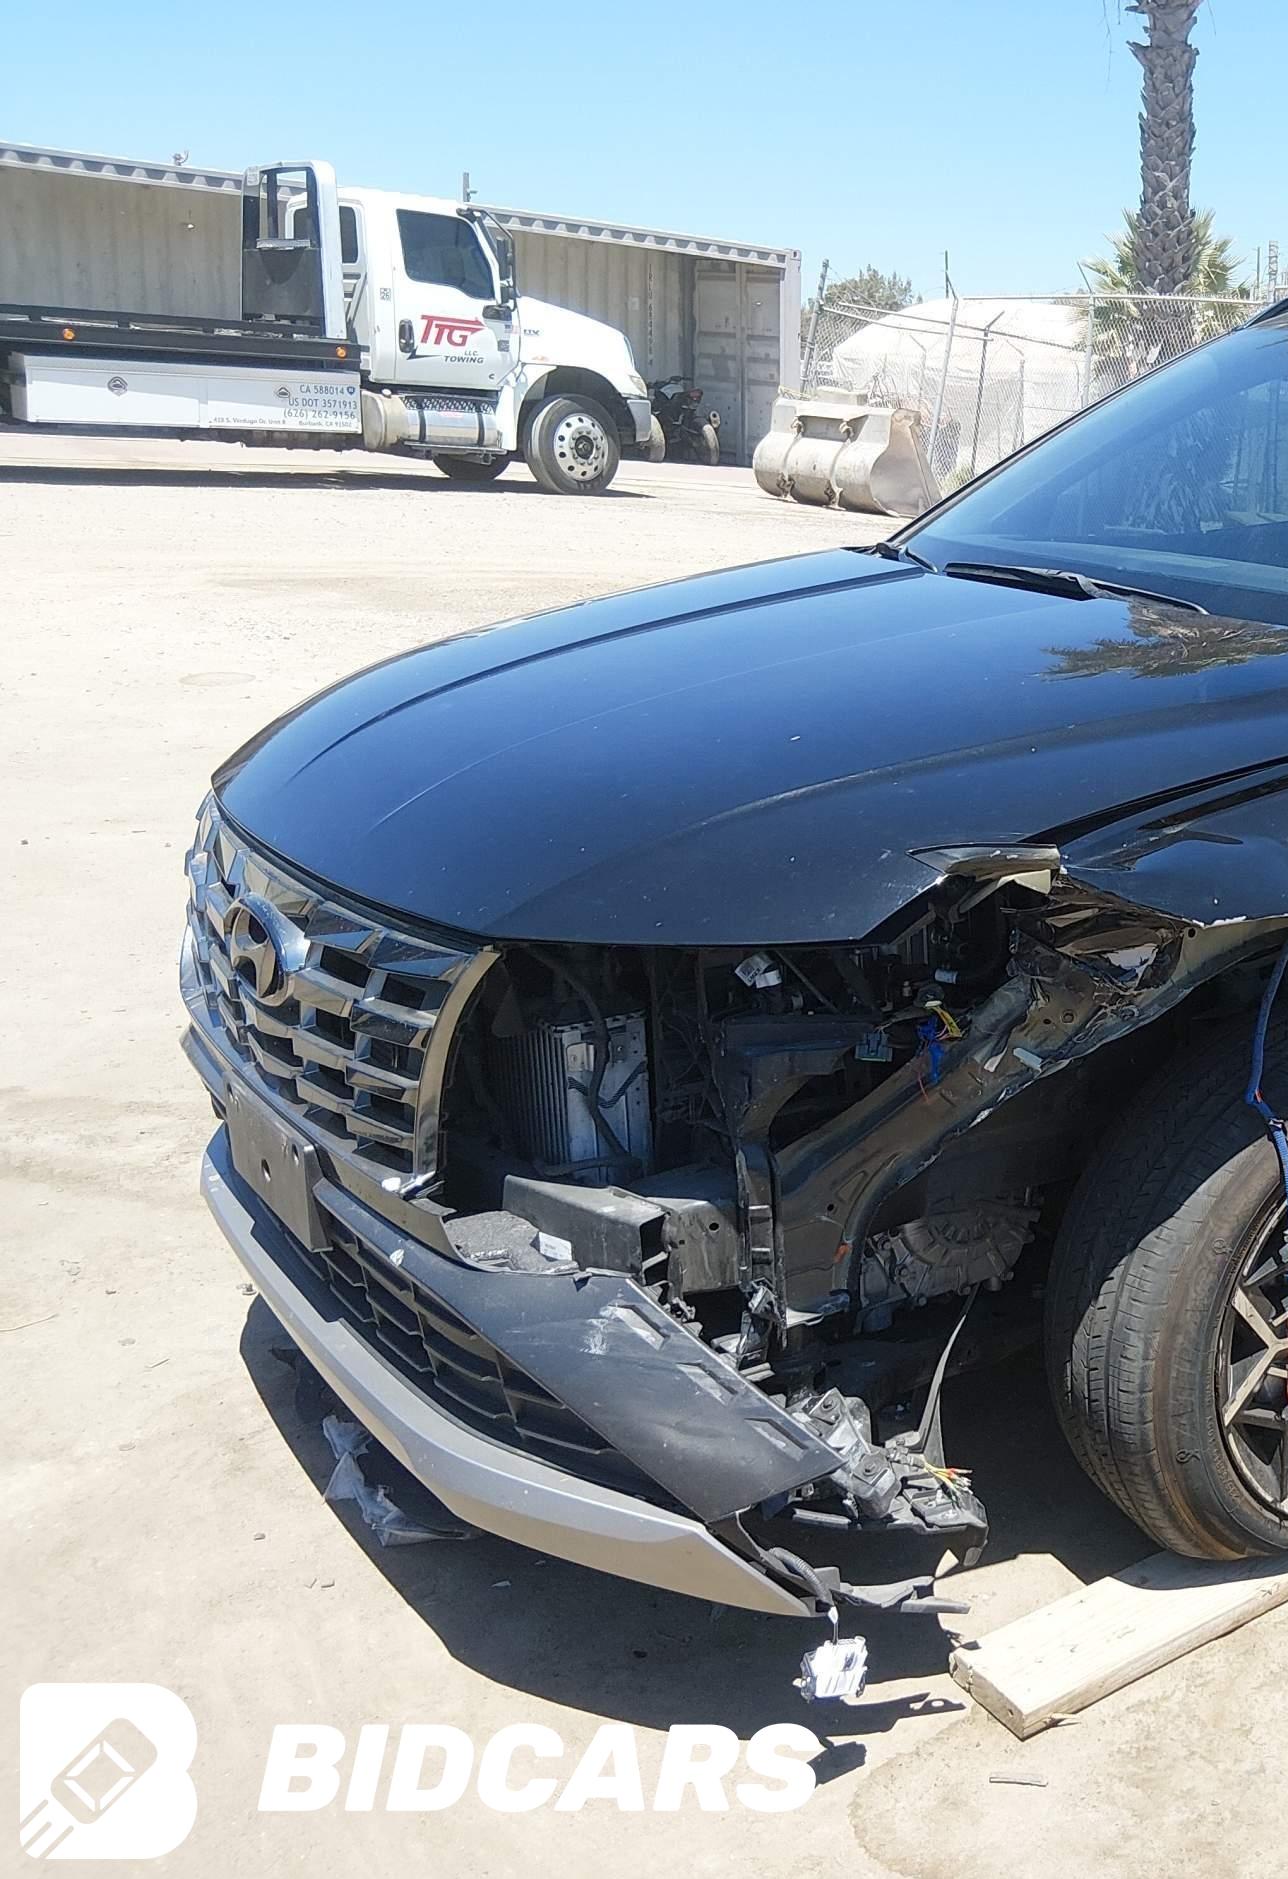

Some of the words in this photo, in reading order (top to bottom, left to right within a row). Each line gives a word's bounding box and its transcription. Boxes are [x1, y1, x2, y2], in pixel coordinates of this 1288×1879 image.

[444, 355, 484, 364] TOWING
[300, 384, 311, 394] CA
[313, 385, 345, 395] 588014
[288, 398, 299, 407] US
[301, 398, 319, 408] DOT
[322, 399, 358, 410] 3571913
[283, 408, 308, 420] (626)
[311, 410, 356, 420] 262-9156
